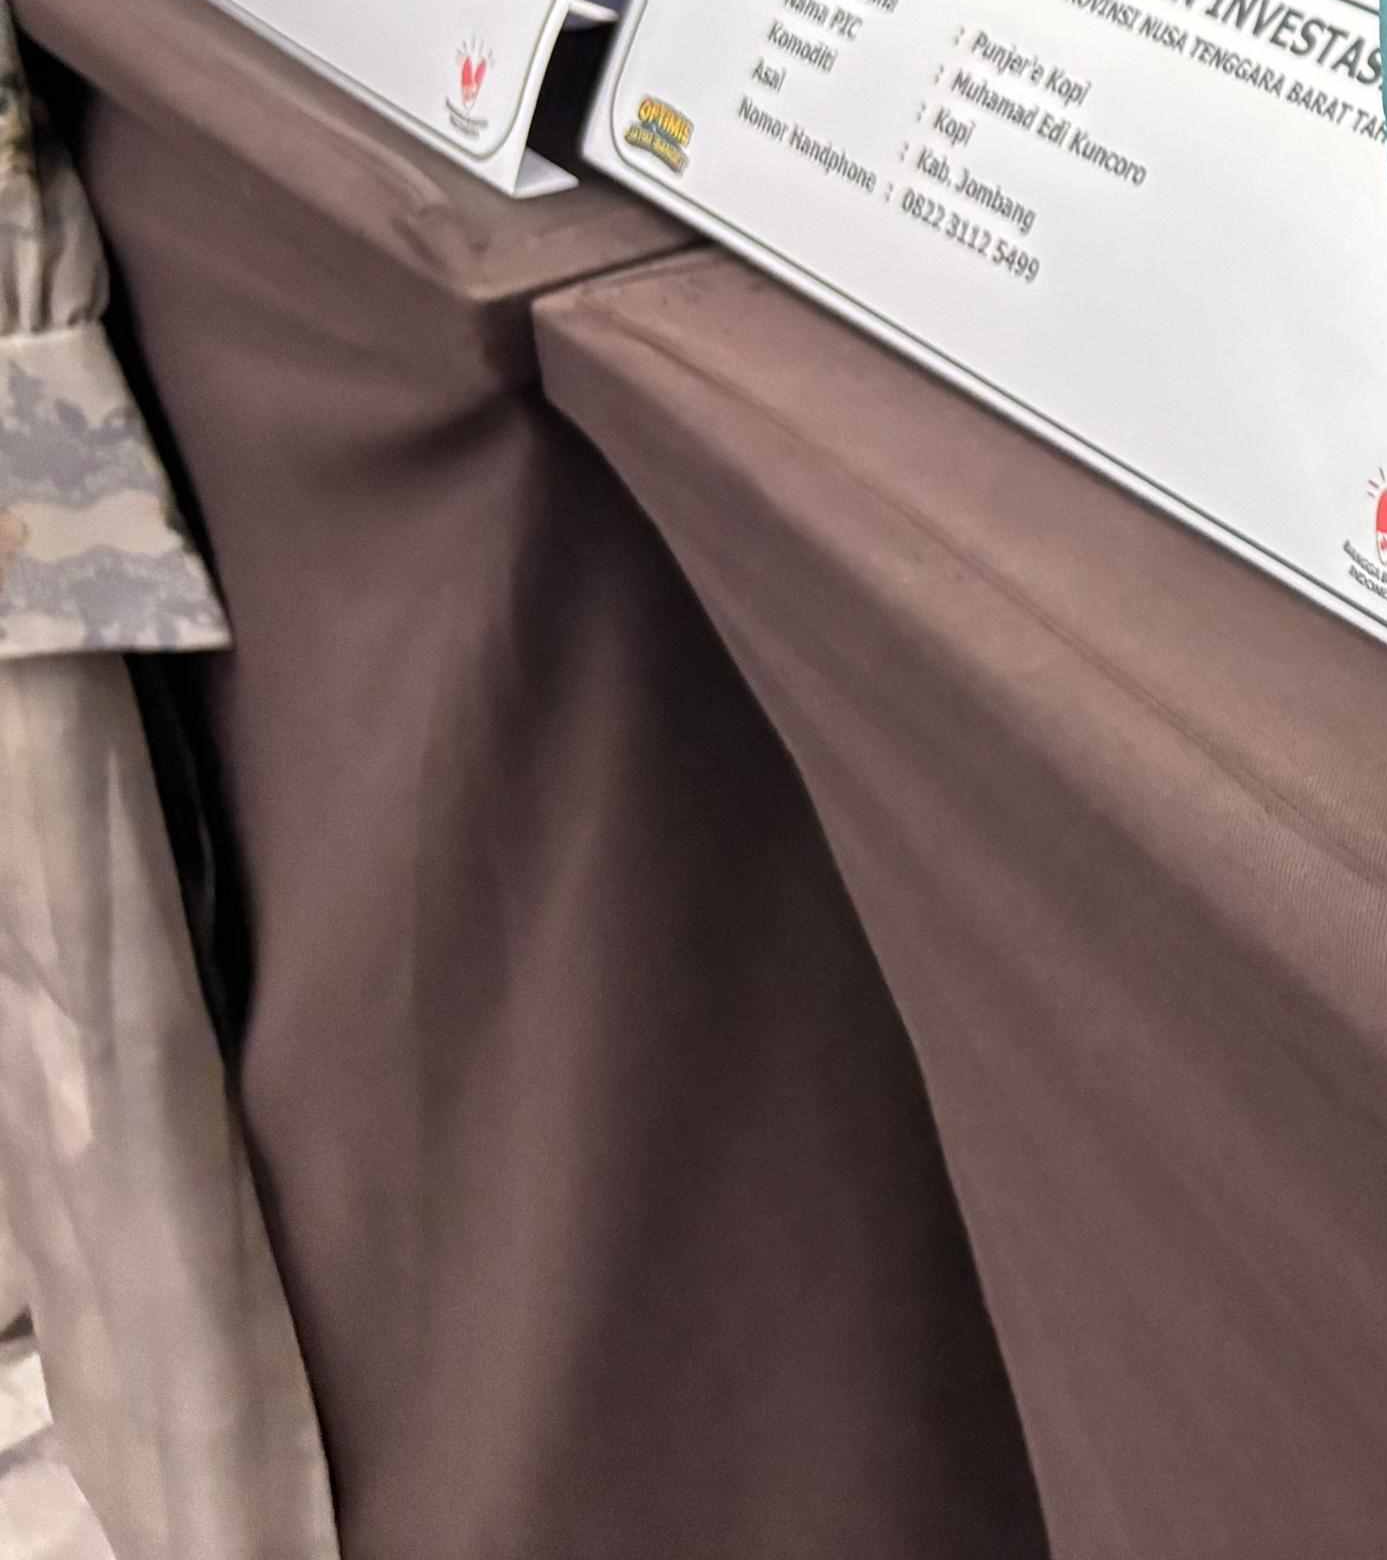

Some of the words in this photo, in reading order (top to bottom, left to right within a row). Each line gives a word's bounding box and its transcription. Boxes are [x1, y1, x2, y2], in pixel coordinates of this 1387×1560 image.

[751, 55, 787, 93] Asal
[915, 146, 953, 187] Kab.
[954, 167, 1037, 236] Jombang
[767, 19, 839, 73] Komoditi
[932, 108, 976, 148] Kopi
[829, 6, 864, 41] PIC
[950, 69, 1040, 132] Muhamad
[1036, 112, 1072, 149] Edi
[1068, 129, 1148, 187] Kuncoro
[970, 30, 1045, 85] Punjer'e
[1045, 66, 1093, 108] Kopi
[1141, 13, 1191, 54] NUSA
[1189, 35, 1289, 98] TENGGARA
[1285, 80, 1356, 126] BARAT
[737, 95, 789, 142] Nomor
[787, 123, 877, 194] Handphone
[900, 188, 946, 233] 0822
[945, 211, 993, 258] 3112
[992, 238, 1040, 283] 5499
